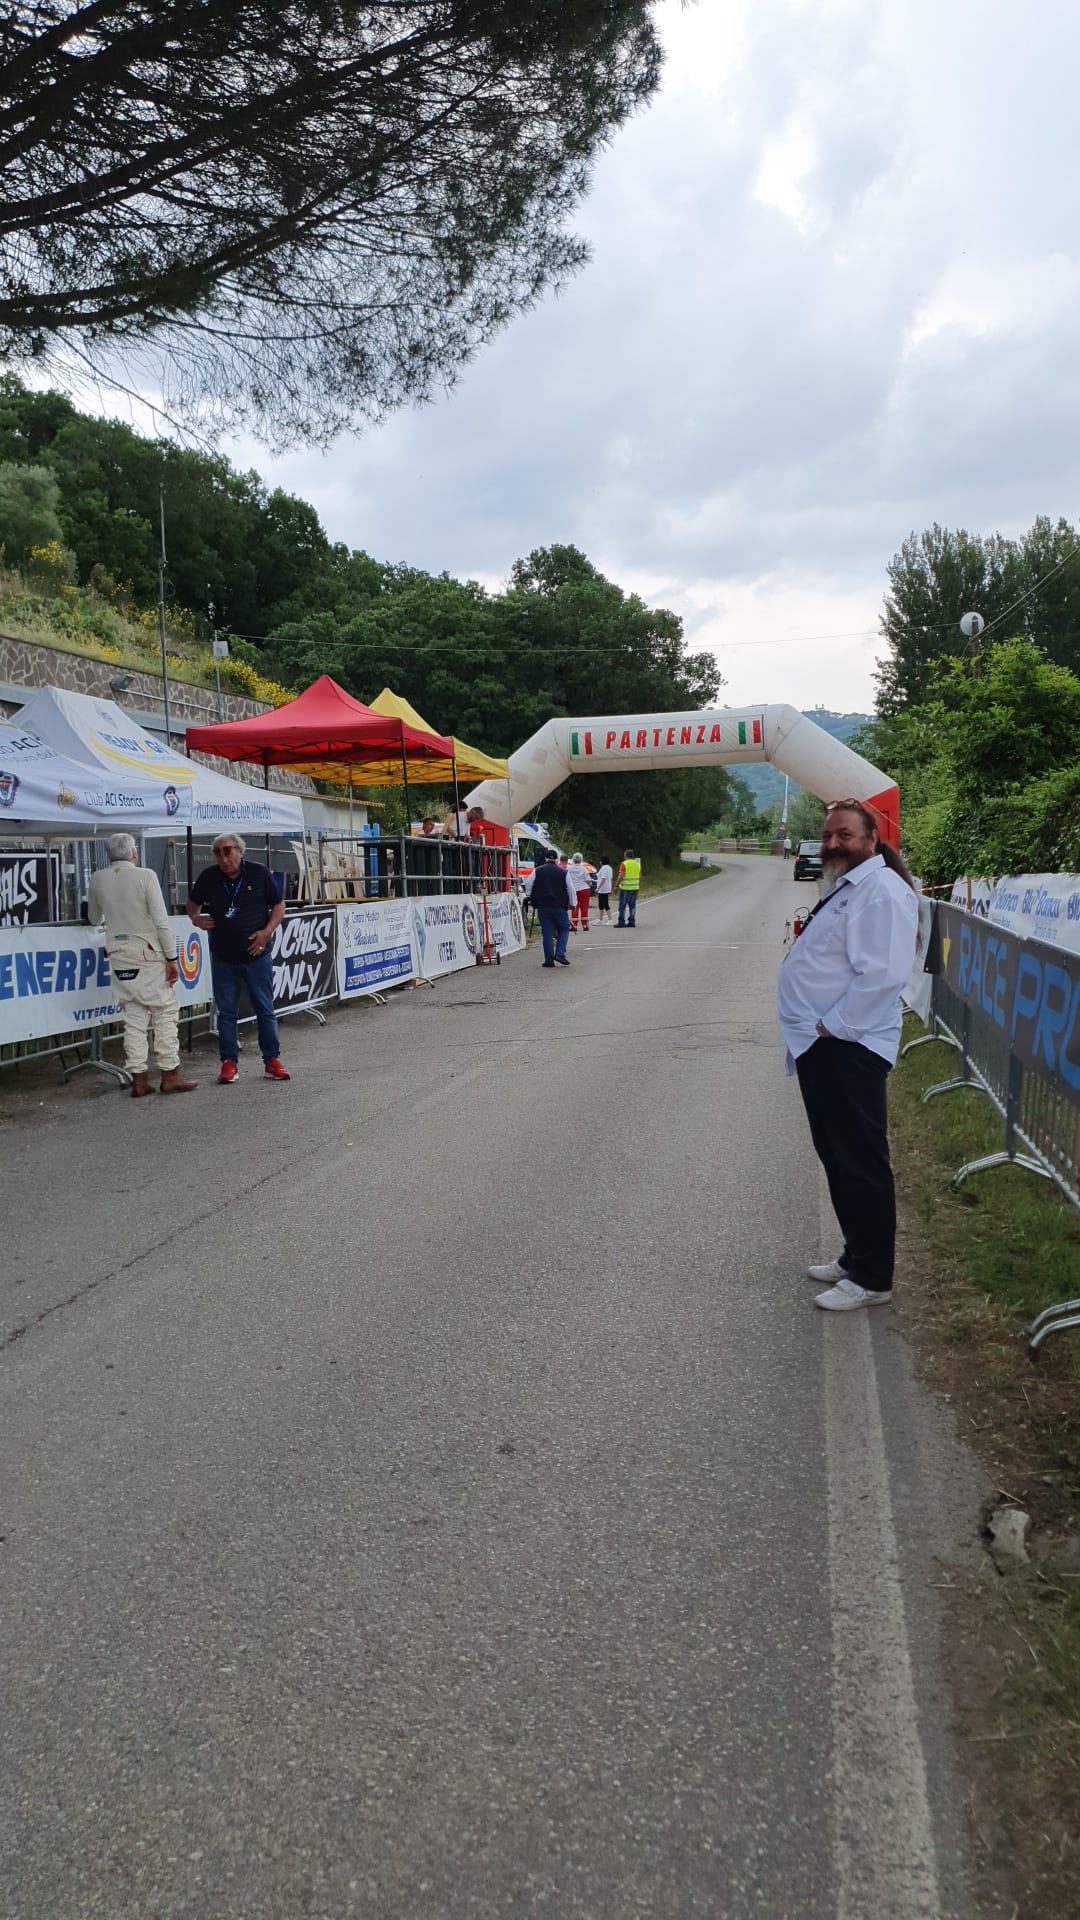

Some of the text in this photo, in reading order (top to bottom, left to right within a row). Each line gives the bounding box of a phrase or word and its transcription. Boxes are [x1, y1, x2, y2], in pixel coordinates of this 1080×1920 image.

[605, 724, 721, 750] PARTENZA
[84, 791, 103, 807] Club
[105, 792, 117, 807] ACI
[196, 801, 235, 820] Automobile
[235, 802, 250, 820] Club
[958, 922, 1007, 1029] RACE
